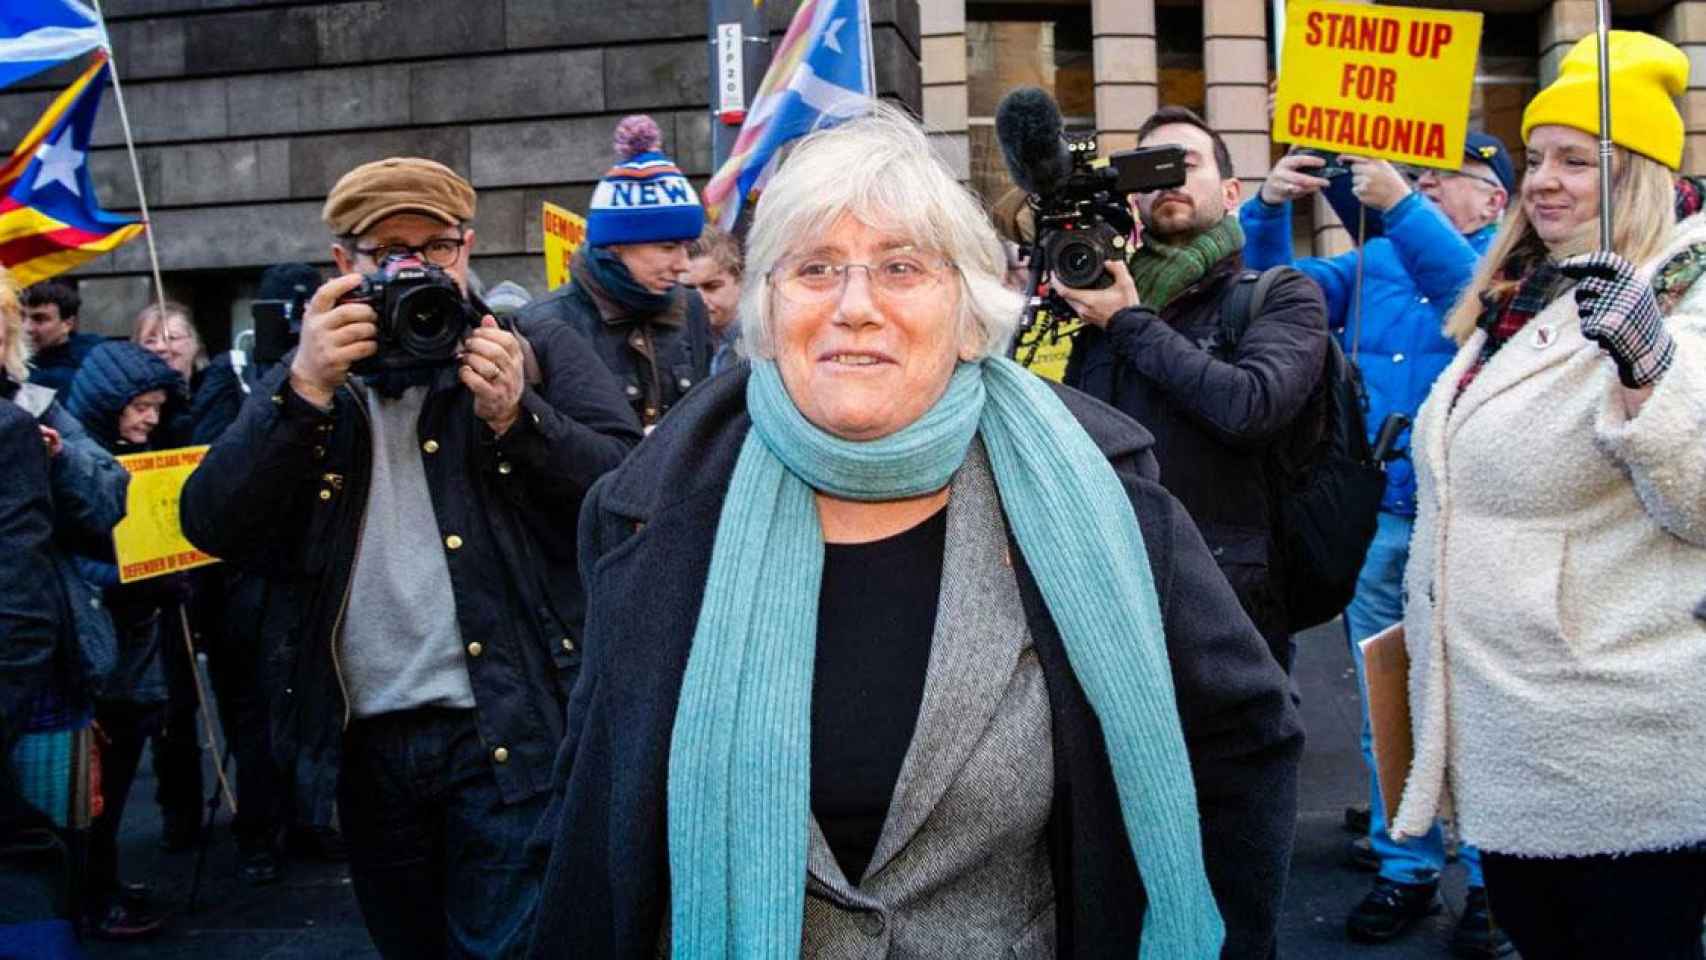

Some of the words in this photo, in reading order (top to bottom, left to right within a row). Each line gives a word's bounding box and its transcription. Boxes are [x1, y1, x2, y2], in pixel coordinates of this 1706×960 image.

[1305, 11, 1400, 54] STAND
[1408, 21, 1453, 59] UP
[1339, 63, 1397, 103] FOR
[1288, 103, 1446, 159] CATALONIA
[610, 180, 689, 207] NEW
[122, 556, 165, 580] DEFENDER
[167, 554, 176, 569] OF
